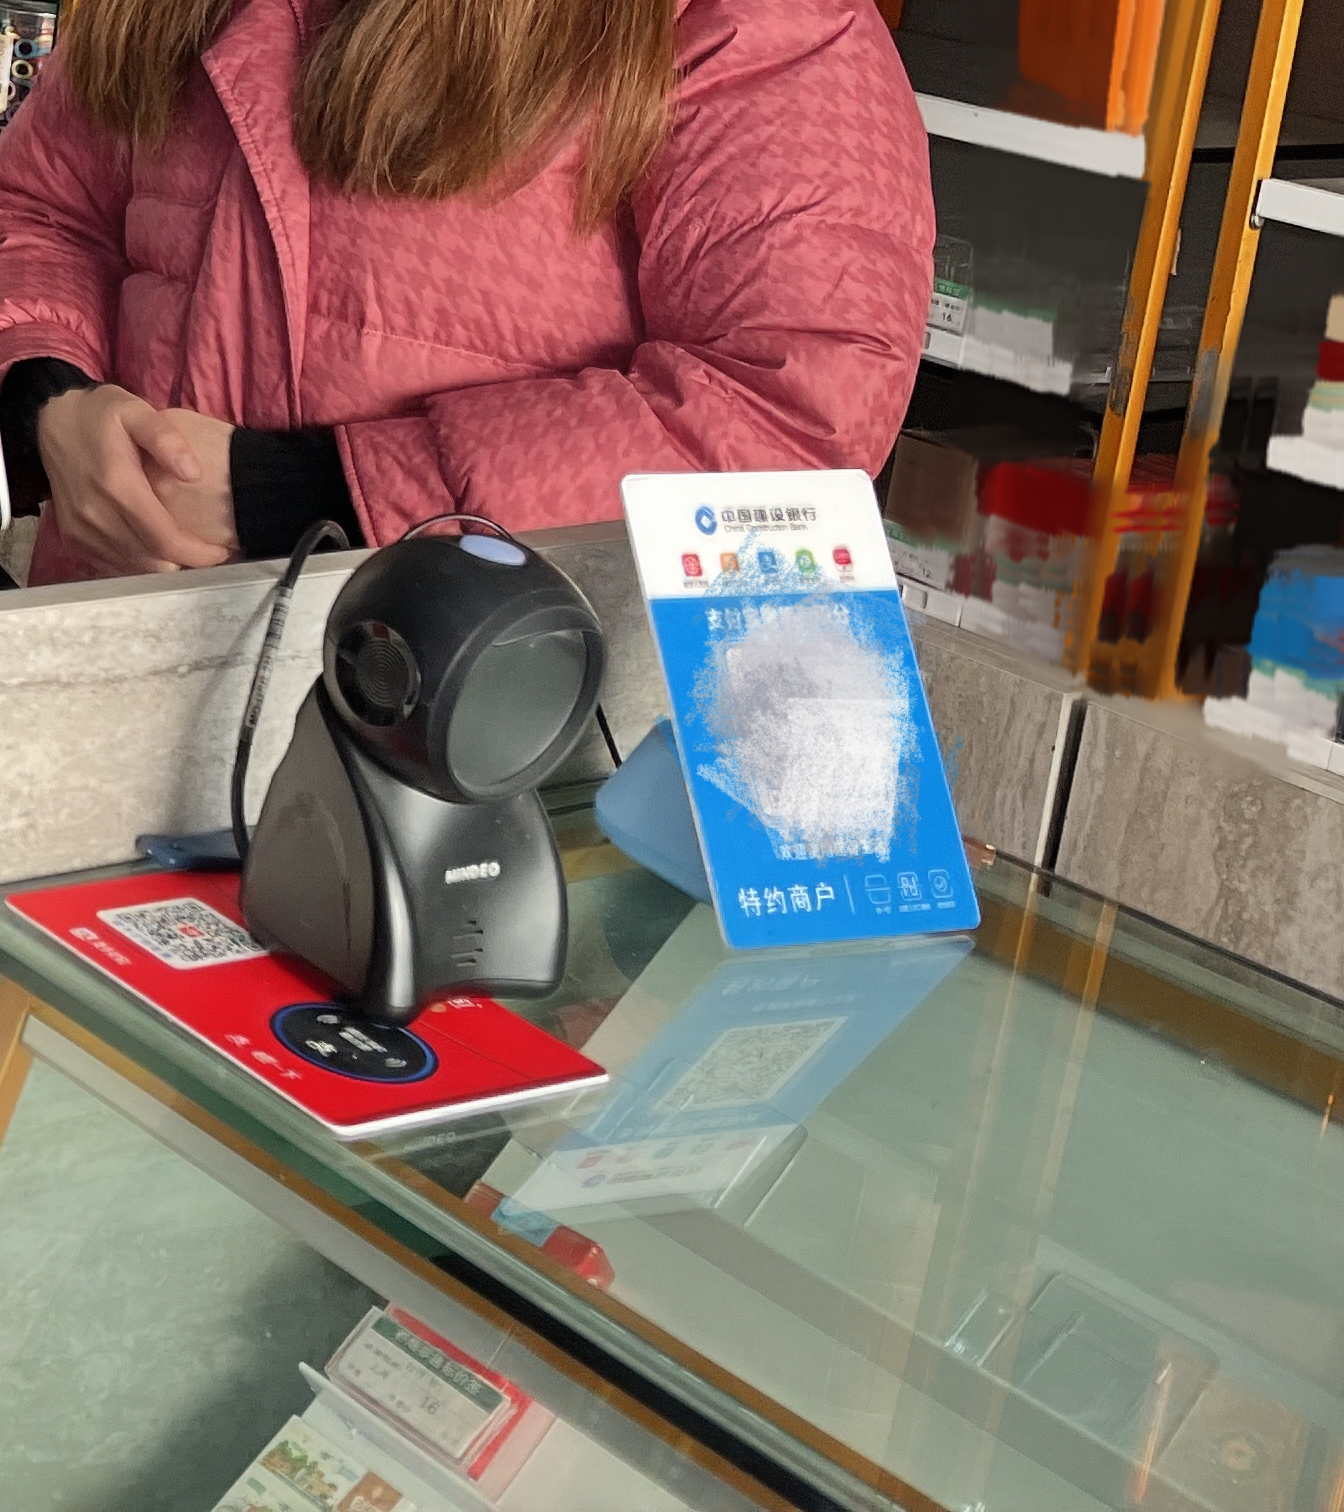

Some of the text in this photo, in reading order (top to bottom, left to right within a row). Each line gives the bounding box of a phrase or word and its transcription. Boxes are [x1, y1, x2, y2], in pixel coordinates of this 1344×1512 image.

[738, 882, 835, 917] 特约商户
[418, 1395, 441, 1416] 16
